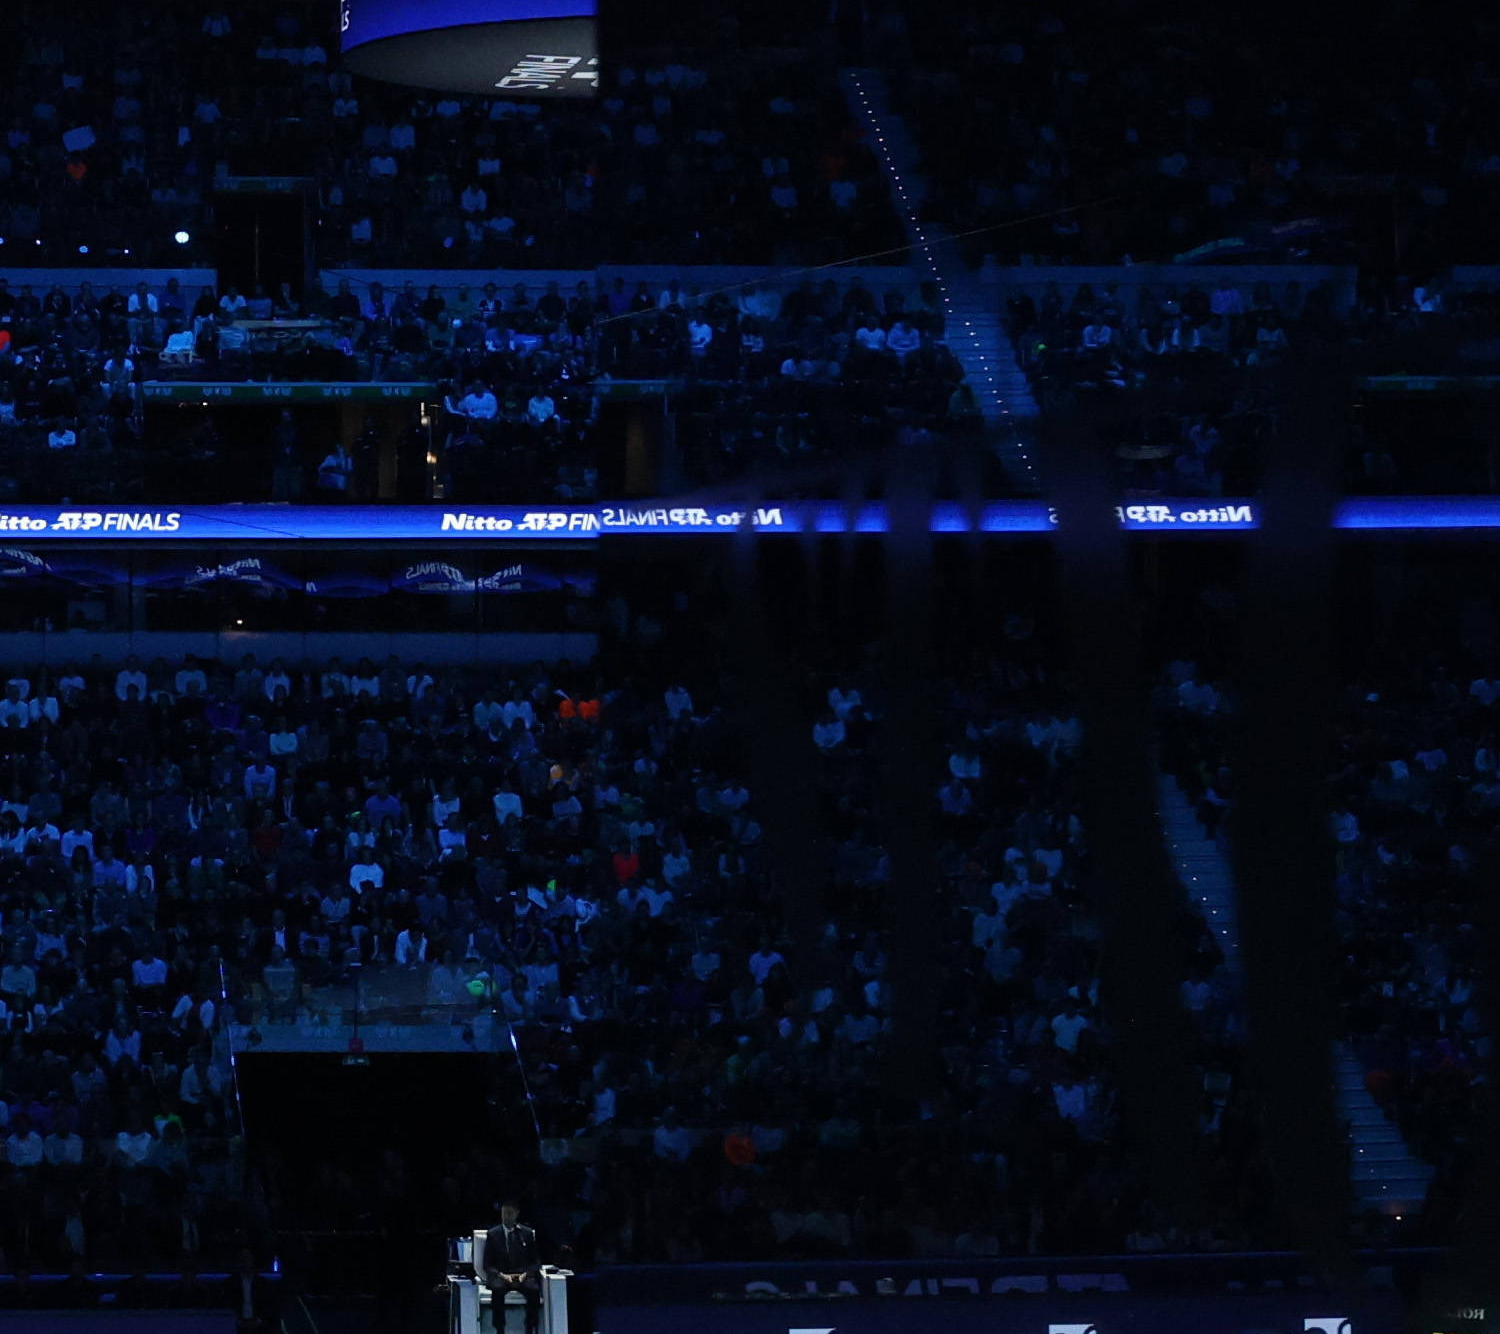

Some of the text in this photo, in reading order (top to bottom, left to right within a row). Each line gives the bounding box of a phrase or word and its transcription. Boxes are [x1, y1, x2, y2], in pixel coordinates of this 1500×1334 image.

[50, 513, 103, 531] ATP
[104, 513, 181, 532] FINALS
[440, 513, 568, 531] Nitto ATP
